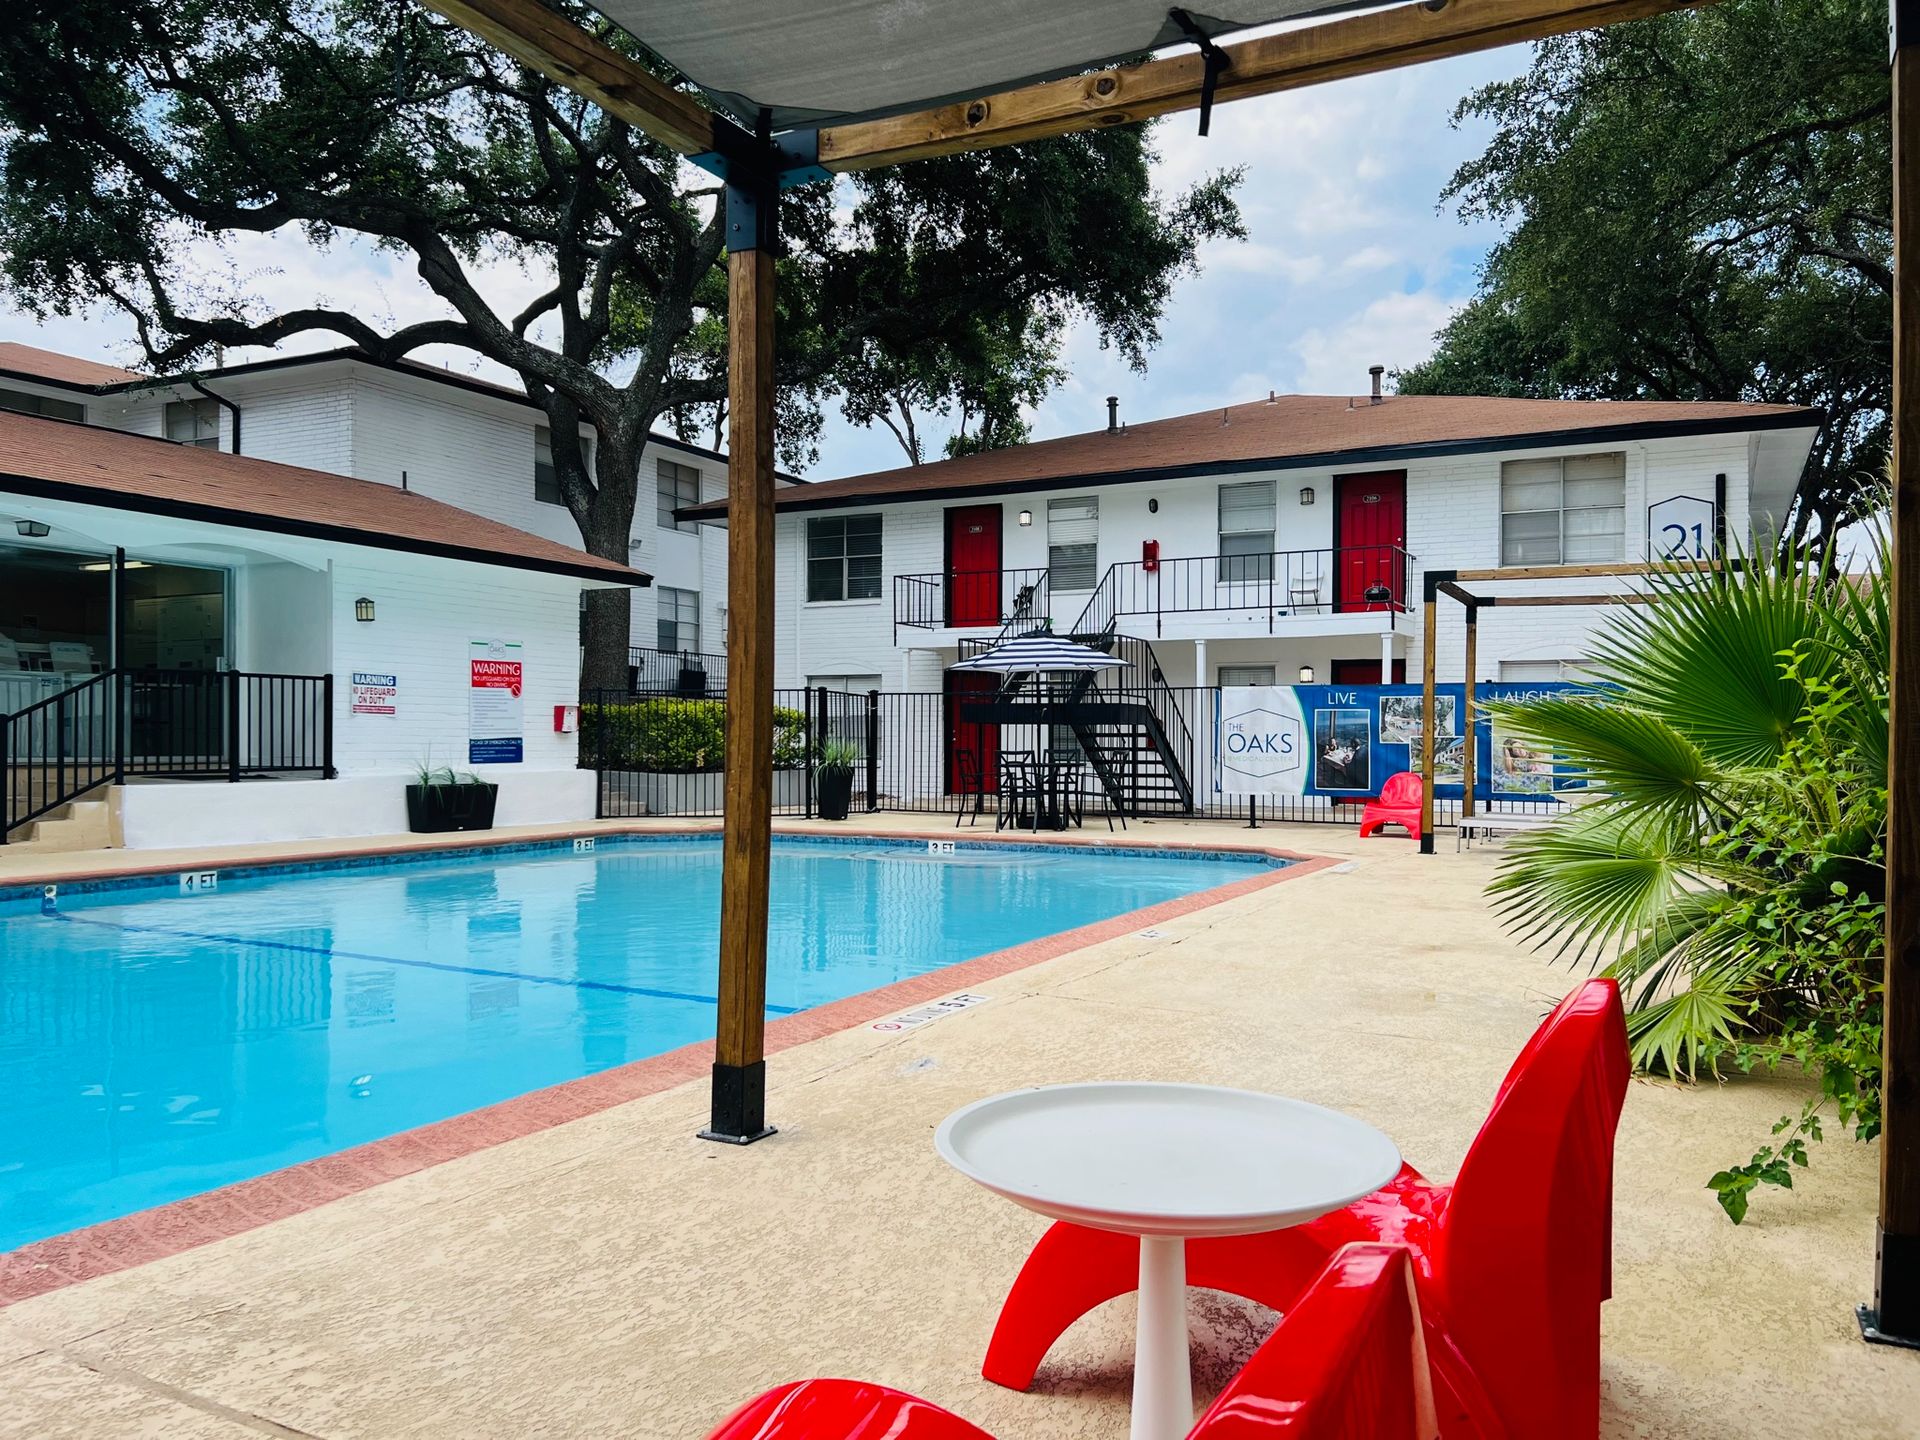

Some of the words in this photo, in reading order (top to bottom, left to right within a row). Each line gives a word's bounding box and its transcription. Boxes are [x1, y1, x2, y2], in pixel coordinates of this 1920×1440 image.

[1662, 523, 1702, 560] 21
[473, 662, 521, 676] WARNING
[354, 674, 394, 686] WARNING
[360, 687, 397, 697] LIFEGUARD
[1327, 692, 1358, 705] LIVE
[1494, 690, 1550, 703] LAUGH
[358, 696, 367, 704] ON
[369, 696, 386, 704] DUTY
[1228, 723, 1245, 732] THE
[1228, 733, 1293, 753] OAKS
